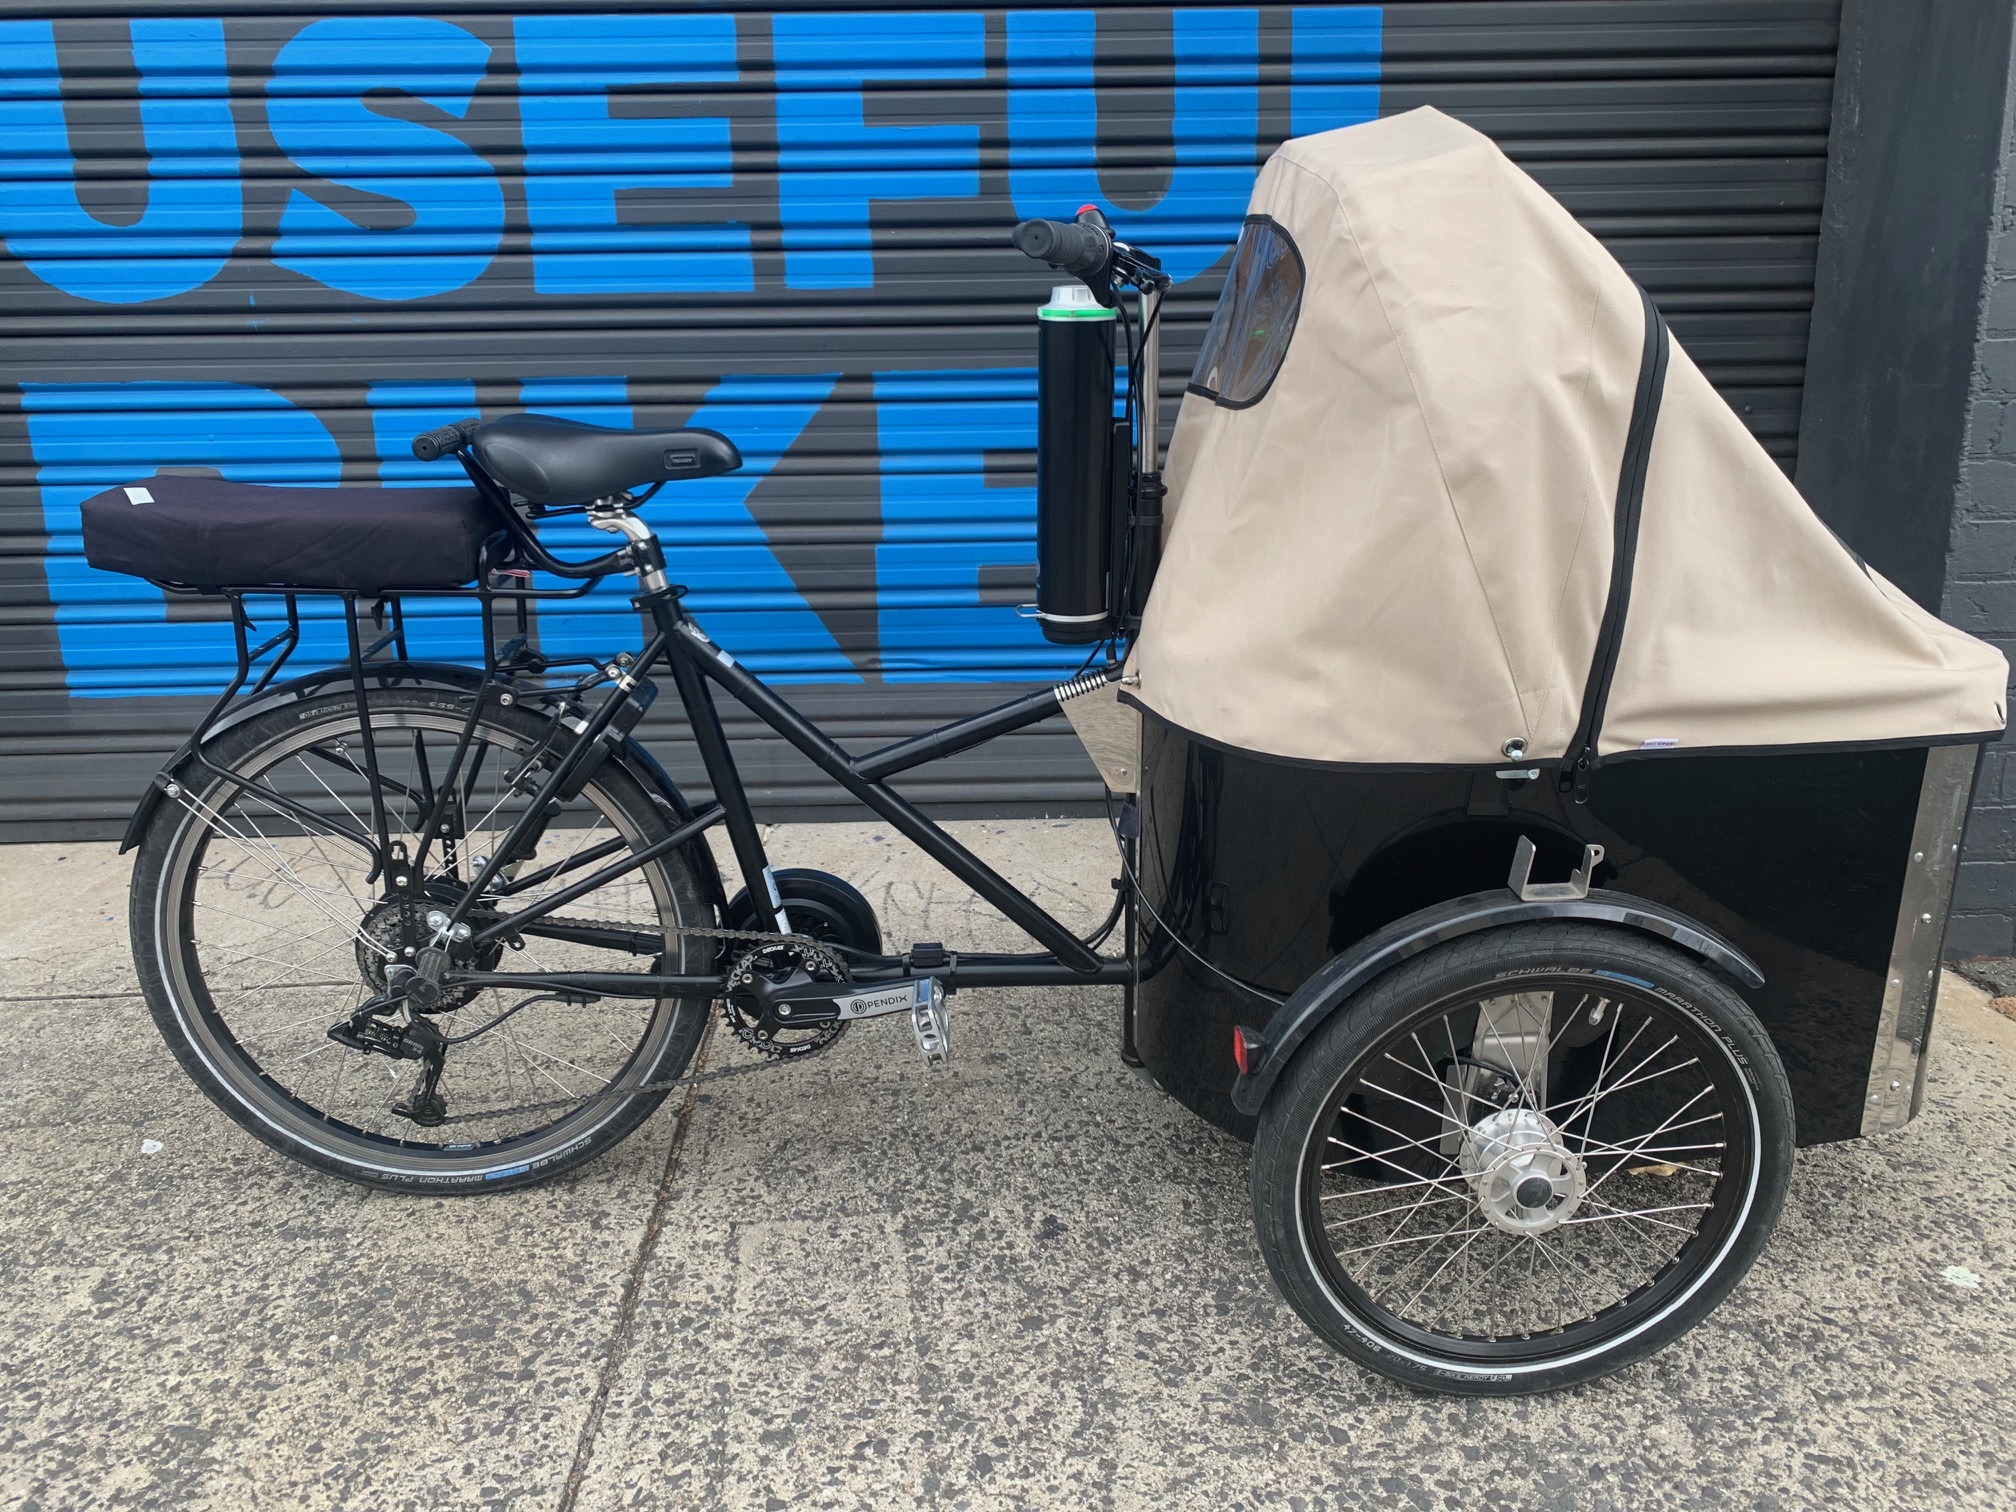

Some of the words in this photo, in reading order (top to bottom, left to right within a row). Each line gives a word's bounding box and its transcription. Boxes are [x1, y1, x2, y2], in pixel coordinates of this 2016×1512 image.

[867, 994, 908, 1009] PENDIX
[1654, 986, 1722, 1032] MARATHON
[1721, 1035, 1749, 1067] PLUS
[532, 1136, 592, 1170] SCHWALBE
[380, 1173, 414, 1183] PLUS
[419, 1174, 483, 1185] MARATHON
